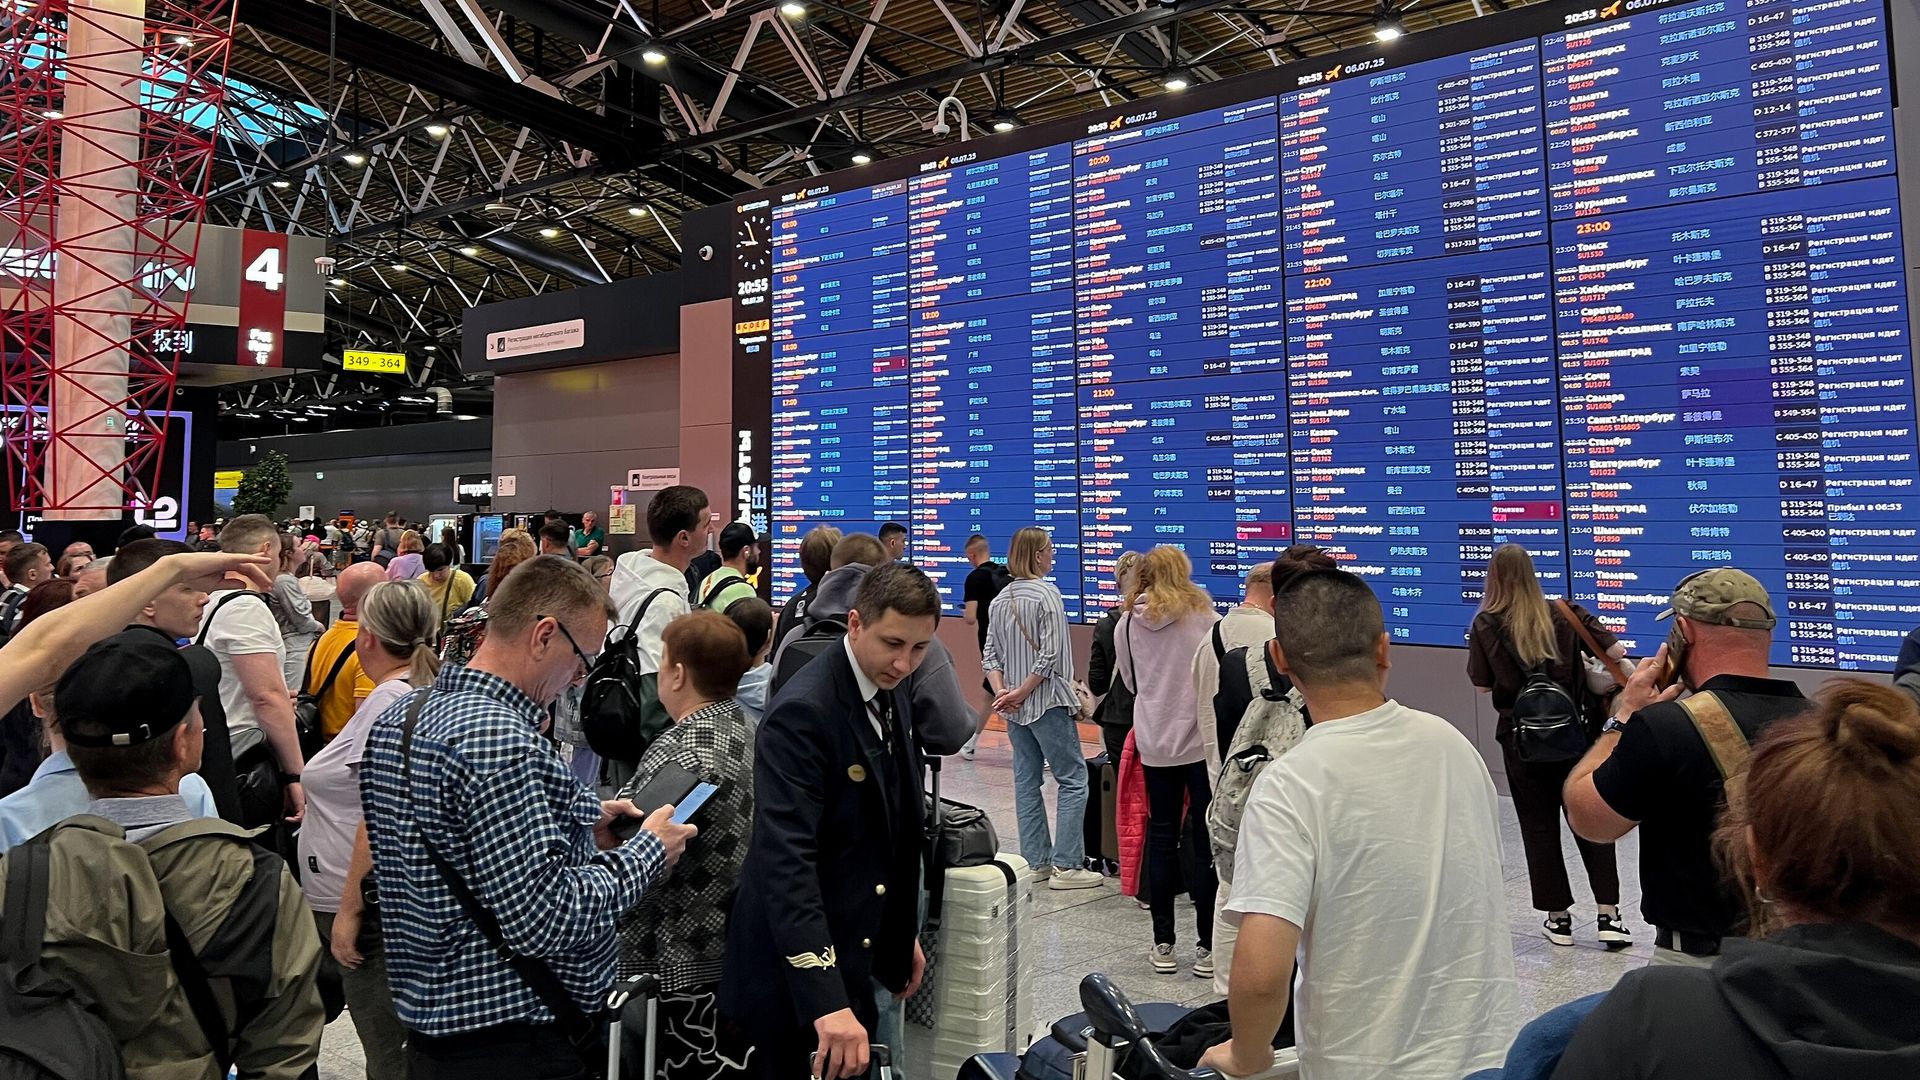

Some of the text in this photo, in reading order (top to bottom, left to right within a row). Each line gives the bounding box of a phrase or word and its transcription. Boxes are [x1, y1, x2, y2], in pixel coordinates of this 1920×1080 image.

[1564, 8, 1596, 24] 20:55
[1757, 11, 1784, 23] 16-47
[1565, 21, 1630, 42] Владивосток
[1793, 16, 1876, 38] Регистрация идет
[1566, 43, 1626, 62] Красноярск
[1795, 39, 1878, 61] Регистрация идет
[1344, 57, 1384, 73] 06.07.25
[1297, 71, 1322, 85] 20:55
[1567, 67, 1619, 83] Кемерово
[1546, 77, 1566, 86] 22:45
[1568, 90, 1608, 104] Алматы
[1763, 103, 1791, 114] 12-14
[1571, 128, 1638, 146] Новосибирск
[1088, 154, 1109, 166] 20:00
[1764, 152, 1798, 164] 355-364
[1299, 163, 1326, 174] Сургут
[1551, 160, 1571, 169] 22:55
[1300, 183, 1316, 192] Уфа
[1574, 195, 1627, 209] Мурманск
[1805, 207, 1891, 223] Регистрация идет
[1576, 220, 1610, 234] 23:00
[1555, 245, 1576, 253] 23:00
[1576, 241, 1608, 251] Томск
[245, 248, 284, 292] 4
[1304, 277, 1331, 288] 22:00
[1480, 271, 1544, 284] Регистрация идет
[737, 277, 768, 295] 20:55
[1454, 279, 1475, 288] 16-47
[1579, 282, 1634, 294] Хабаровск
[1305, 309, 1373, 323] Санкт-Петербург
[1559, 309, 1579, 317] 23:15
[1580, 305, 1622, 316] Саратов
[1581, 322, 1672, 337] Южно-Сахалинск
[1306, 352, 1328, 360] Омск
[1582, 347, 1652, 359] Калининград
[348, 355, 369, 366] 349
[380, 357, 400, 368] 364
[1583, 372, 1610, 381] Сочи
[1093, 388, 1114, 397] 21:00
[1584, 393, 1625, 403] Самара
[1782, 408, 1816, 416] 349-354
[1819, 403, 1906, 413] Регистрация идет
[1586, 412, 1675, 424] Санкт-Петербург
[1587, 436, 1631, 447] Стамбул
[1684, 433, 1733, 444] 伊斯坦布尔
[1567, 460, 1587, 468] 23:35
[1588, 457, 1661, 469] Екатеринбург
[738, 430, 752, 524] ылеты
[1589, 481, 1632, 490] Тюмень
[1687, 480, 1707, 490] 秋明
[1591, 503, 1647, 513] Волгоград
[1827, 503, 1865, 512] Прибыл
[1593, 526, 1643, 534] Шымкент
[1828, 528, 1890, 536] Регистрация
[1593, 548, 1630, 557] Астана
[1691, 549, 1731, 560] 阿斯塔纳
[1594, 570, 1637, 580] Тюмень
[1574, 592, 1595, 600] 23:45
[1798, 601, 1826, 609] 16-47
[1597, 615, 1627, 625] Омск
